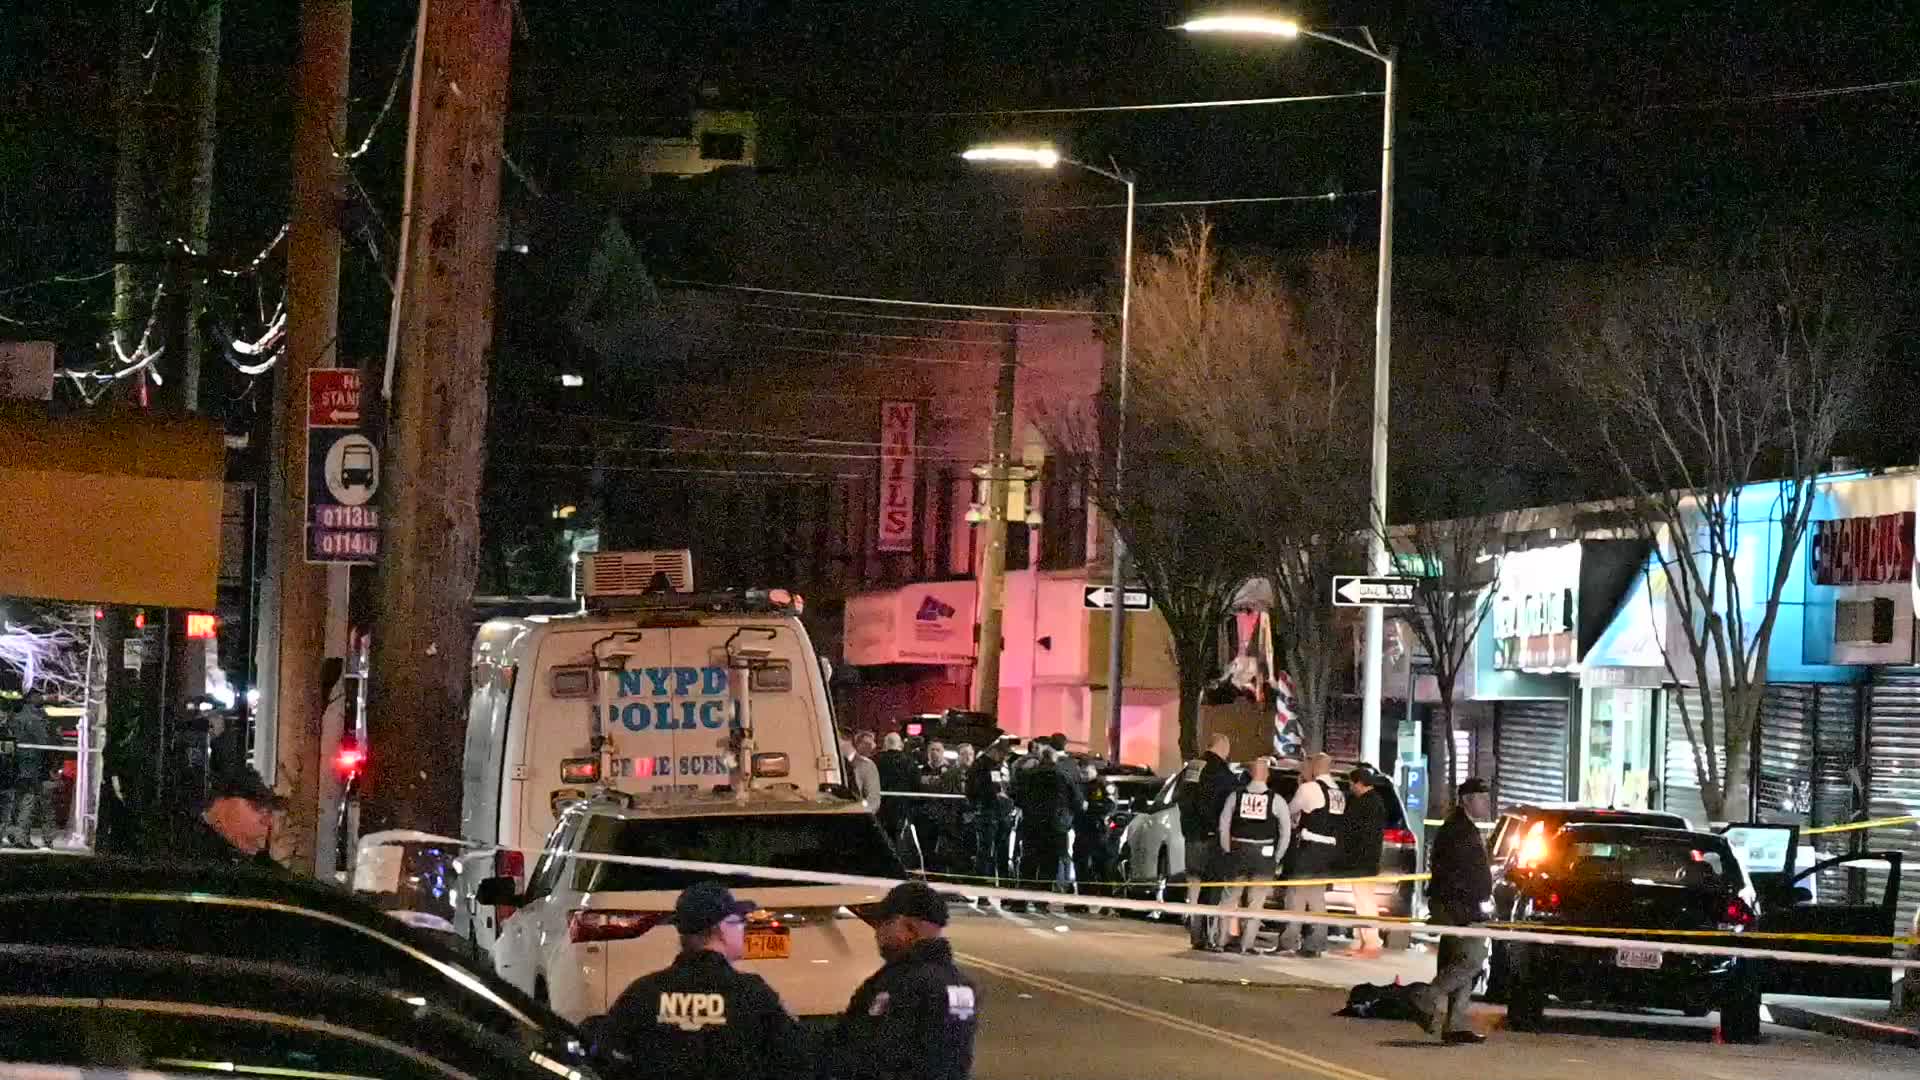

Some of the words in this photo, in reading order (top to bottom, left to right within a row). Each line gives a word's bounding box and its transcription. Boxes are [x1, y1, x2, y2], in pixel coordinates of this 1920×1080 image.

[885, 406, 913, 534] NAILS
[617, 667, 727, 697] NYPD
[679, 755, 730, 775] SCEN
[659, 992, 725, 1017] NYPD
